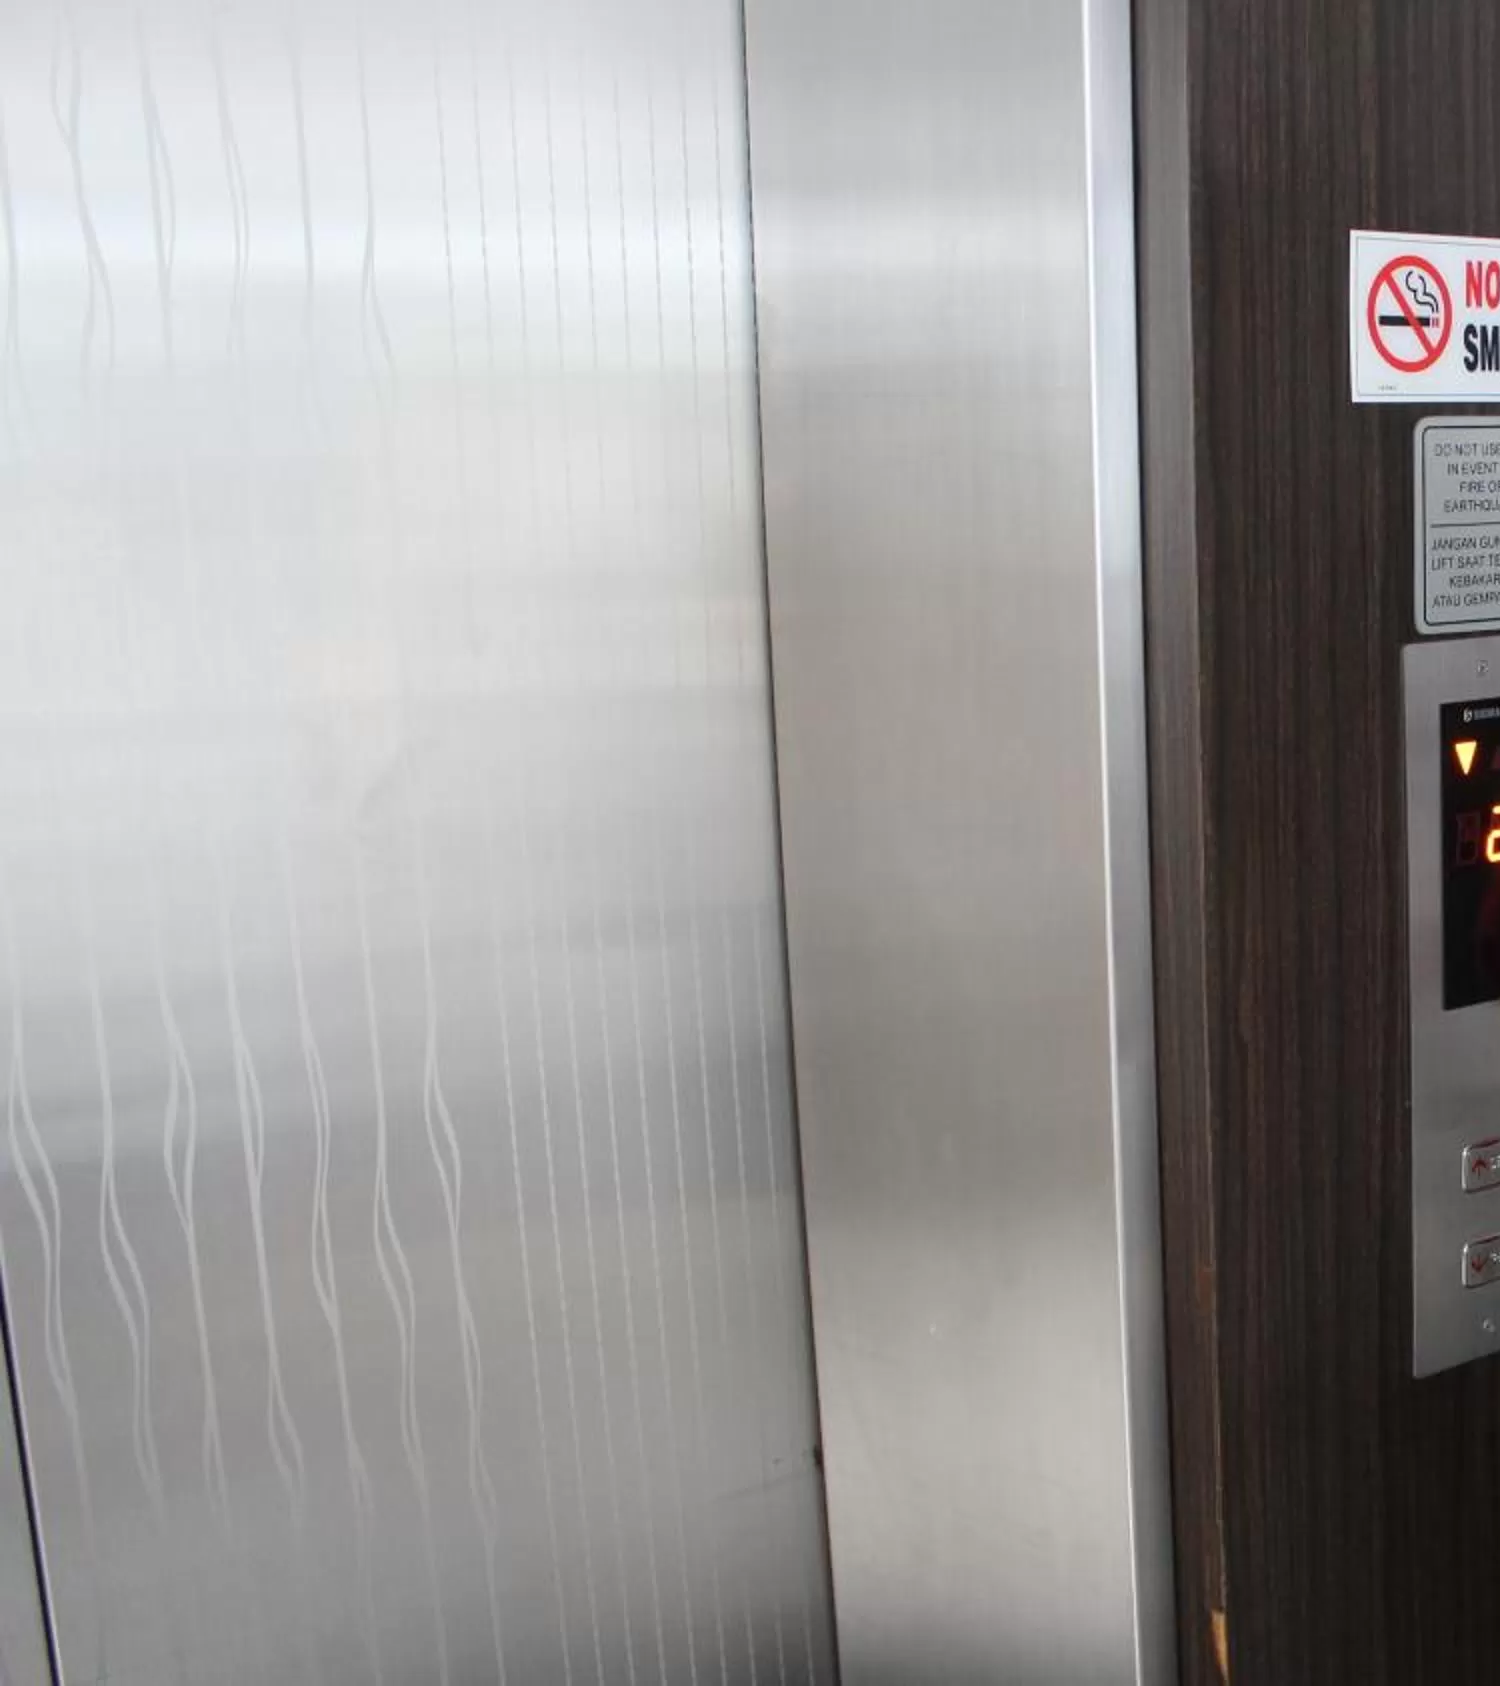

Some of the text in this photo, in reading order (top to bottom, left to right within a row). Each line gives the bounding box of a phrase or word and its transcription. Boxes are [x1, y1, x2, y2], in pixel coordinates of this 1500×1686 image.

[1434, 443, 1452, 457] DO
[1455, 443, 1477, 457] NOT
[1447, 463, 1459, 476] IN
[1461, 461, 1499, 475] EVENT
[1459, 481, 1485, 493] FIRE
[1431, 536, 1477, 550] JANGAN
[1431, 556, 1454, 571] LIFT
[1457, 555, 1485, 569] SAAT
[1432, 594, 1461, 609] ATAU
